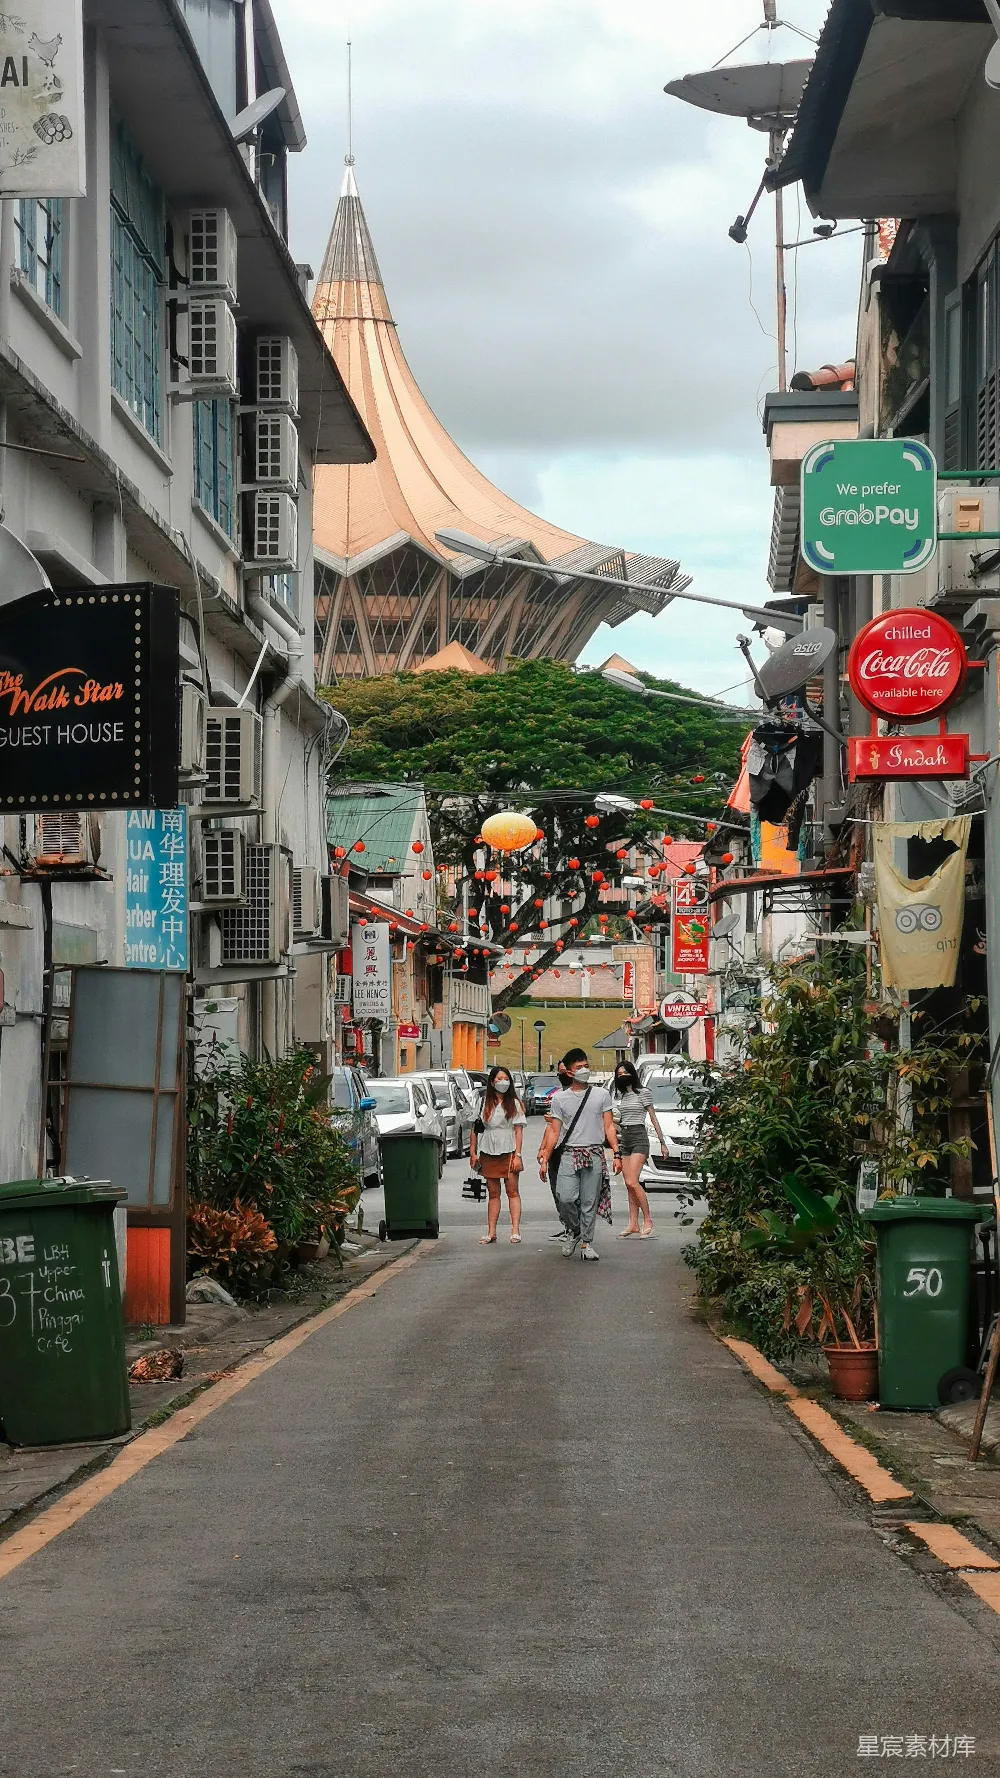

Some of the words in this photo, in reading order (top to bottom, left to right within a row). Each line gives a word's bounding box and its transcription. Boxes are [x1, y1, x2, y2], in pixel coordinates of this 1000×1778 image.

[836, 484, 858, 495] We
[861, 482, 901, 497] prefer
[819, 503, 919, 530] GrabPay
[884, 626, 931, 640] chilled
[792, 641, 823, 656] astro
[0, 670, 24, 691] The
[0, 673, 71, 716] Walk
[74, 679, 125, 706] Star
[872, 688, 918, 699] available
[920, 687, 944, 697] here
[57, 722, 124, 745] HOUSE
[886, 744, 949, 768] Indah
[158, 808, 186, 969] 南华理发中心
[354, 989, 364, 998] LEE
[667, 1004, 703, 1012] VINTAGE
[903, 1267, 943, 1297] 50
[43, 1285, 85, 1303] China
